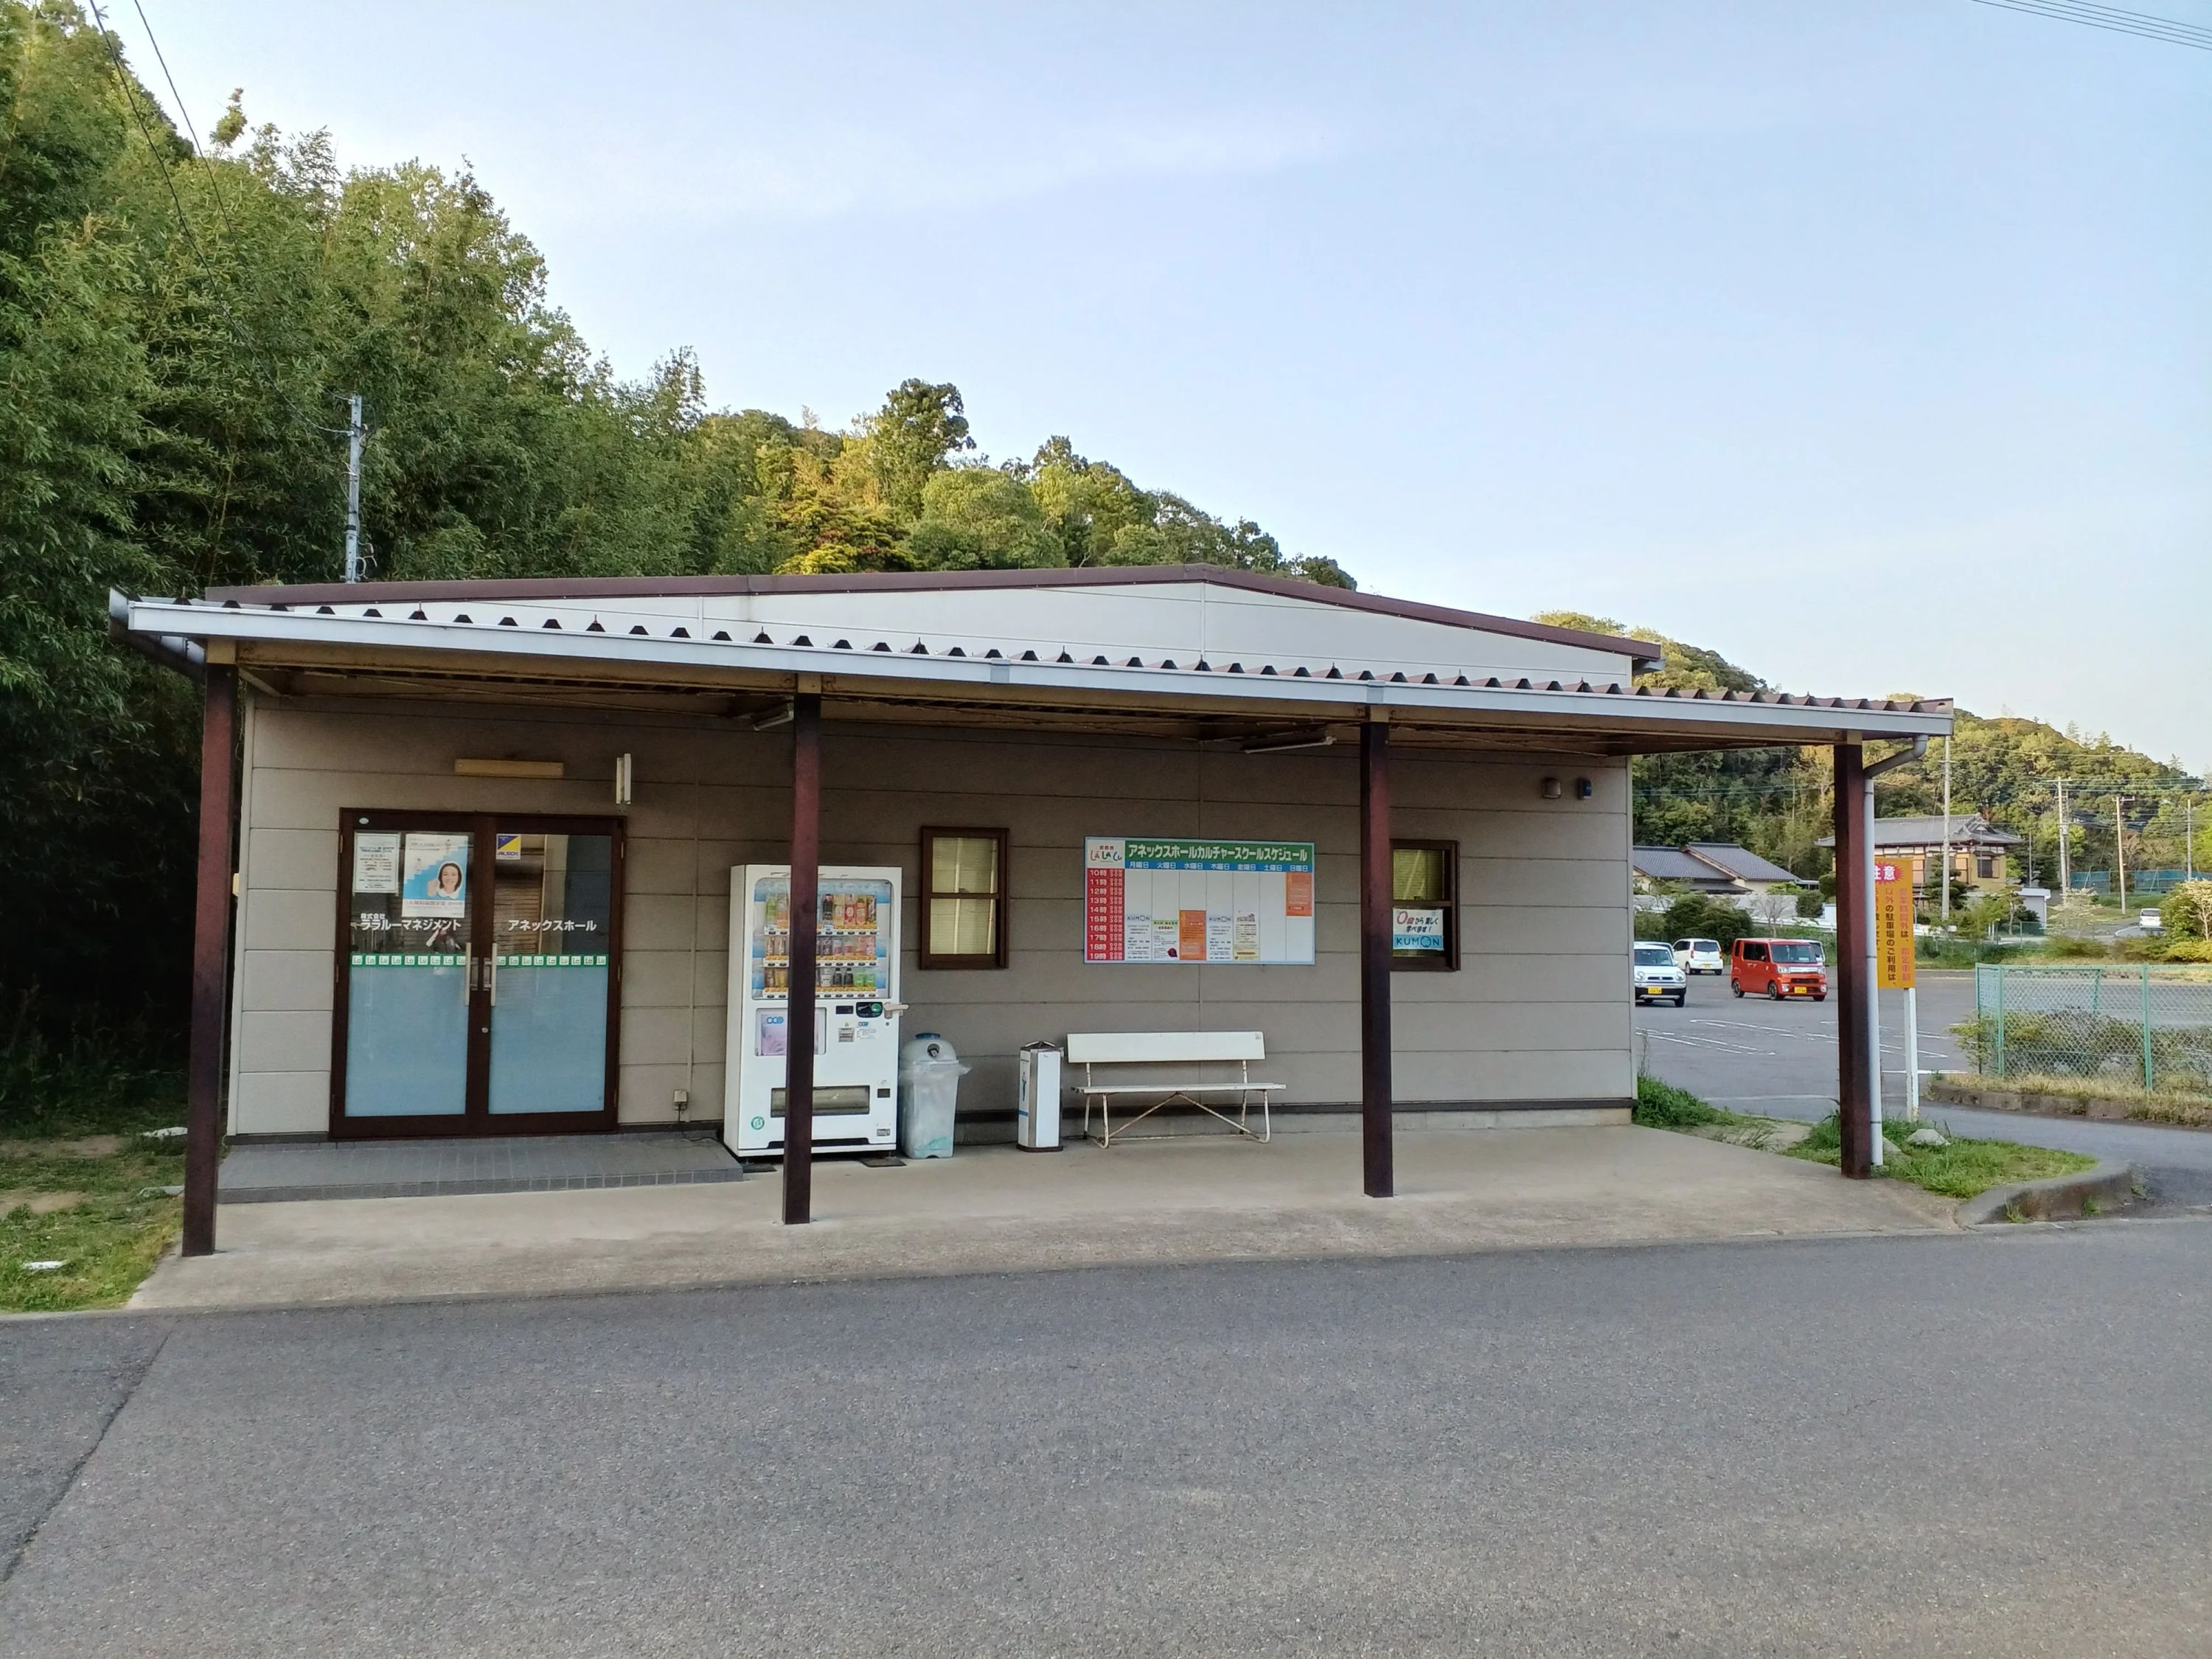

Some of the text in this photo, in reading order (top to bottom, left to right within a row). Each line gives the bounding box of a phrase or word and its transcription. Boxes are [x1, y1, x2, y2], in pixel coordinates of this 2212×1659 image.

[1128, 844, 1307, 862] アネックスホールカルチャースクールスケジュール
[1130, 860, 1150, 869] 月曜日
[1157, 861, 1177, 869] 火曜日
[1184, 862, 1203, 870] 水曜日
[361, 919, 462, 931] ララルーマネジメント
[508, 919, 597, 931] アネックスホール
[1396, 936, 1440, 948] KUMON
